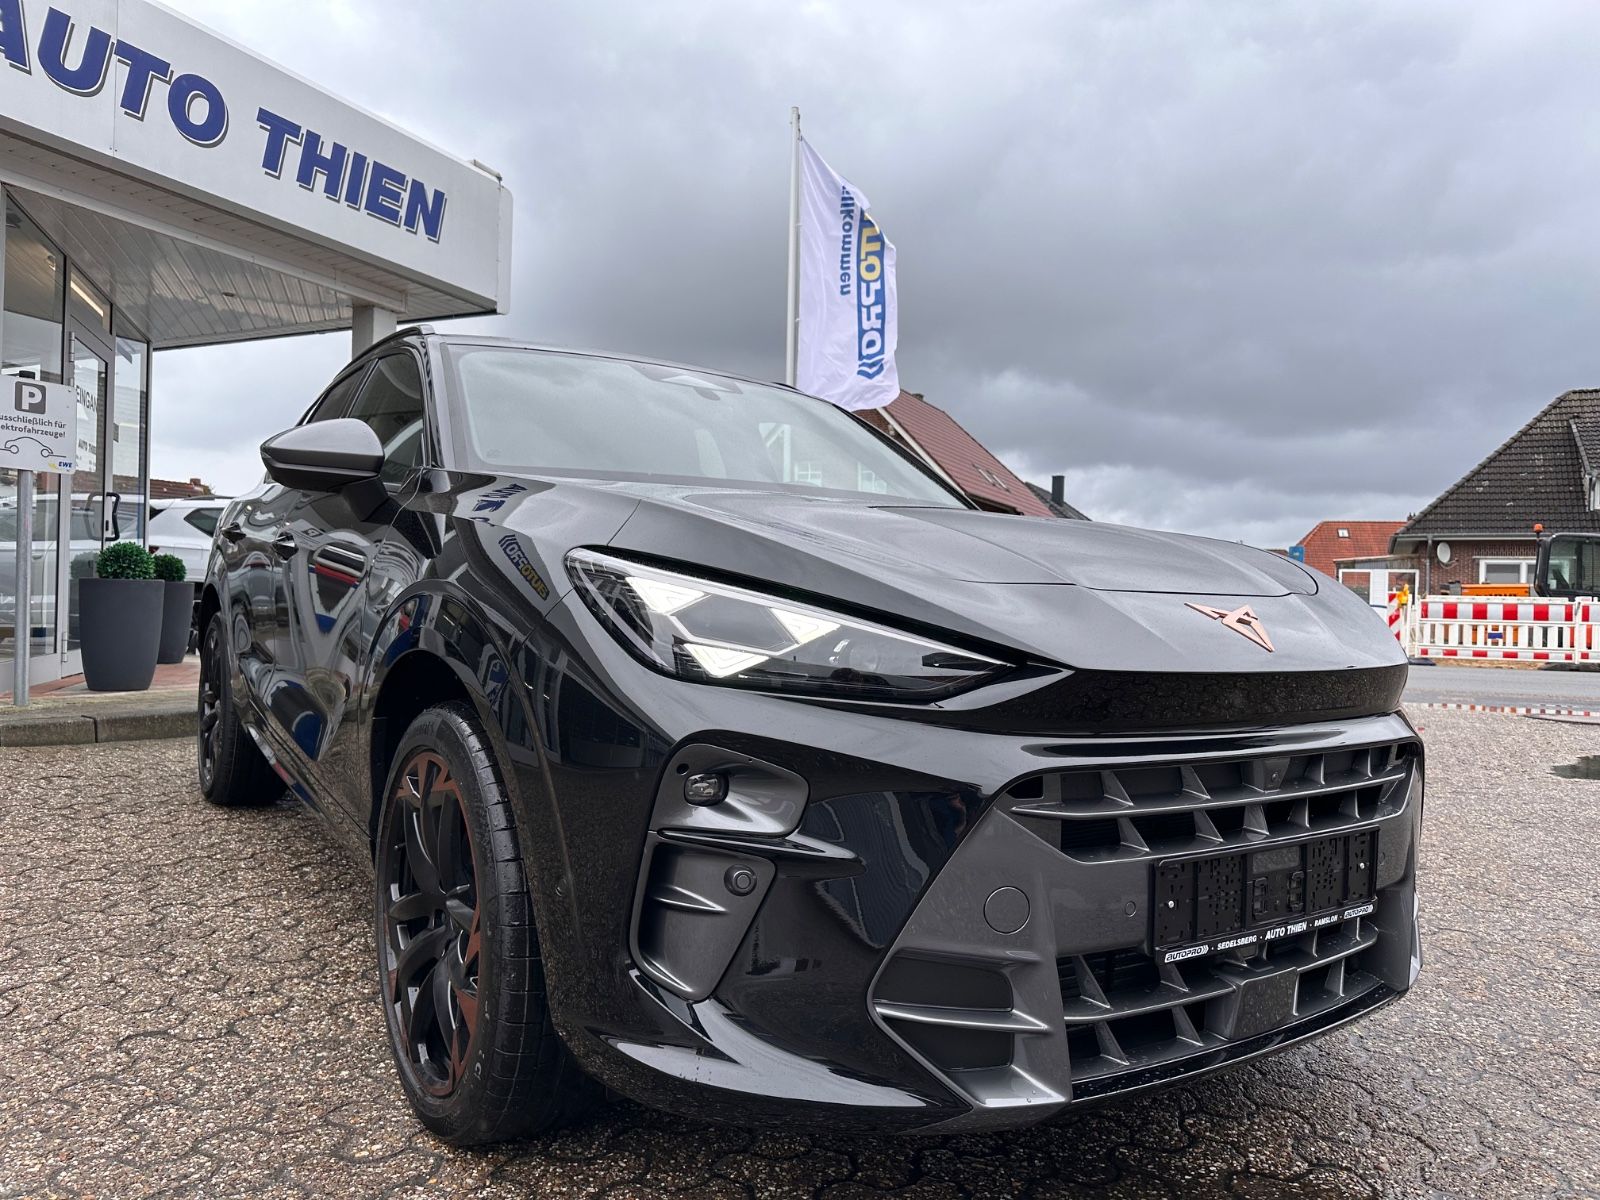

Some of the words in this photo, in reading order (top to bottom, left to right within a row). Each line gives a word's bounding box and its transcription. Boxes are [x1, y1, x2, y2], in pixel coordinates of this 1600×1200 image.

[257, 107, 447, 244] THIEN
[21, 384, 43, 410] P
[54, 420, 67, 429] für
[1217, 935, 1258, 950] SEDELSBERG
[1264, 927, 1286, 940] AUTO
[1287, 921, 1308, 935] THIEN
